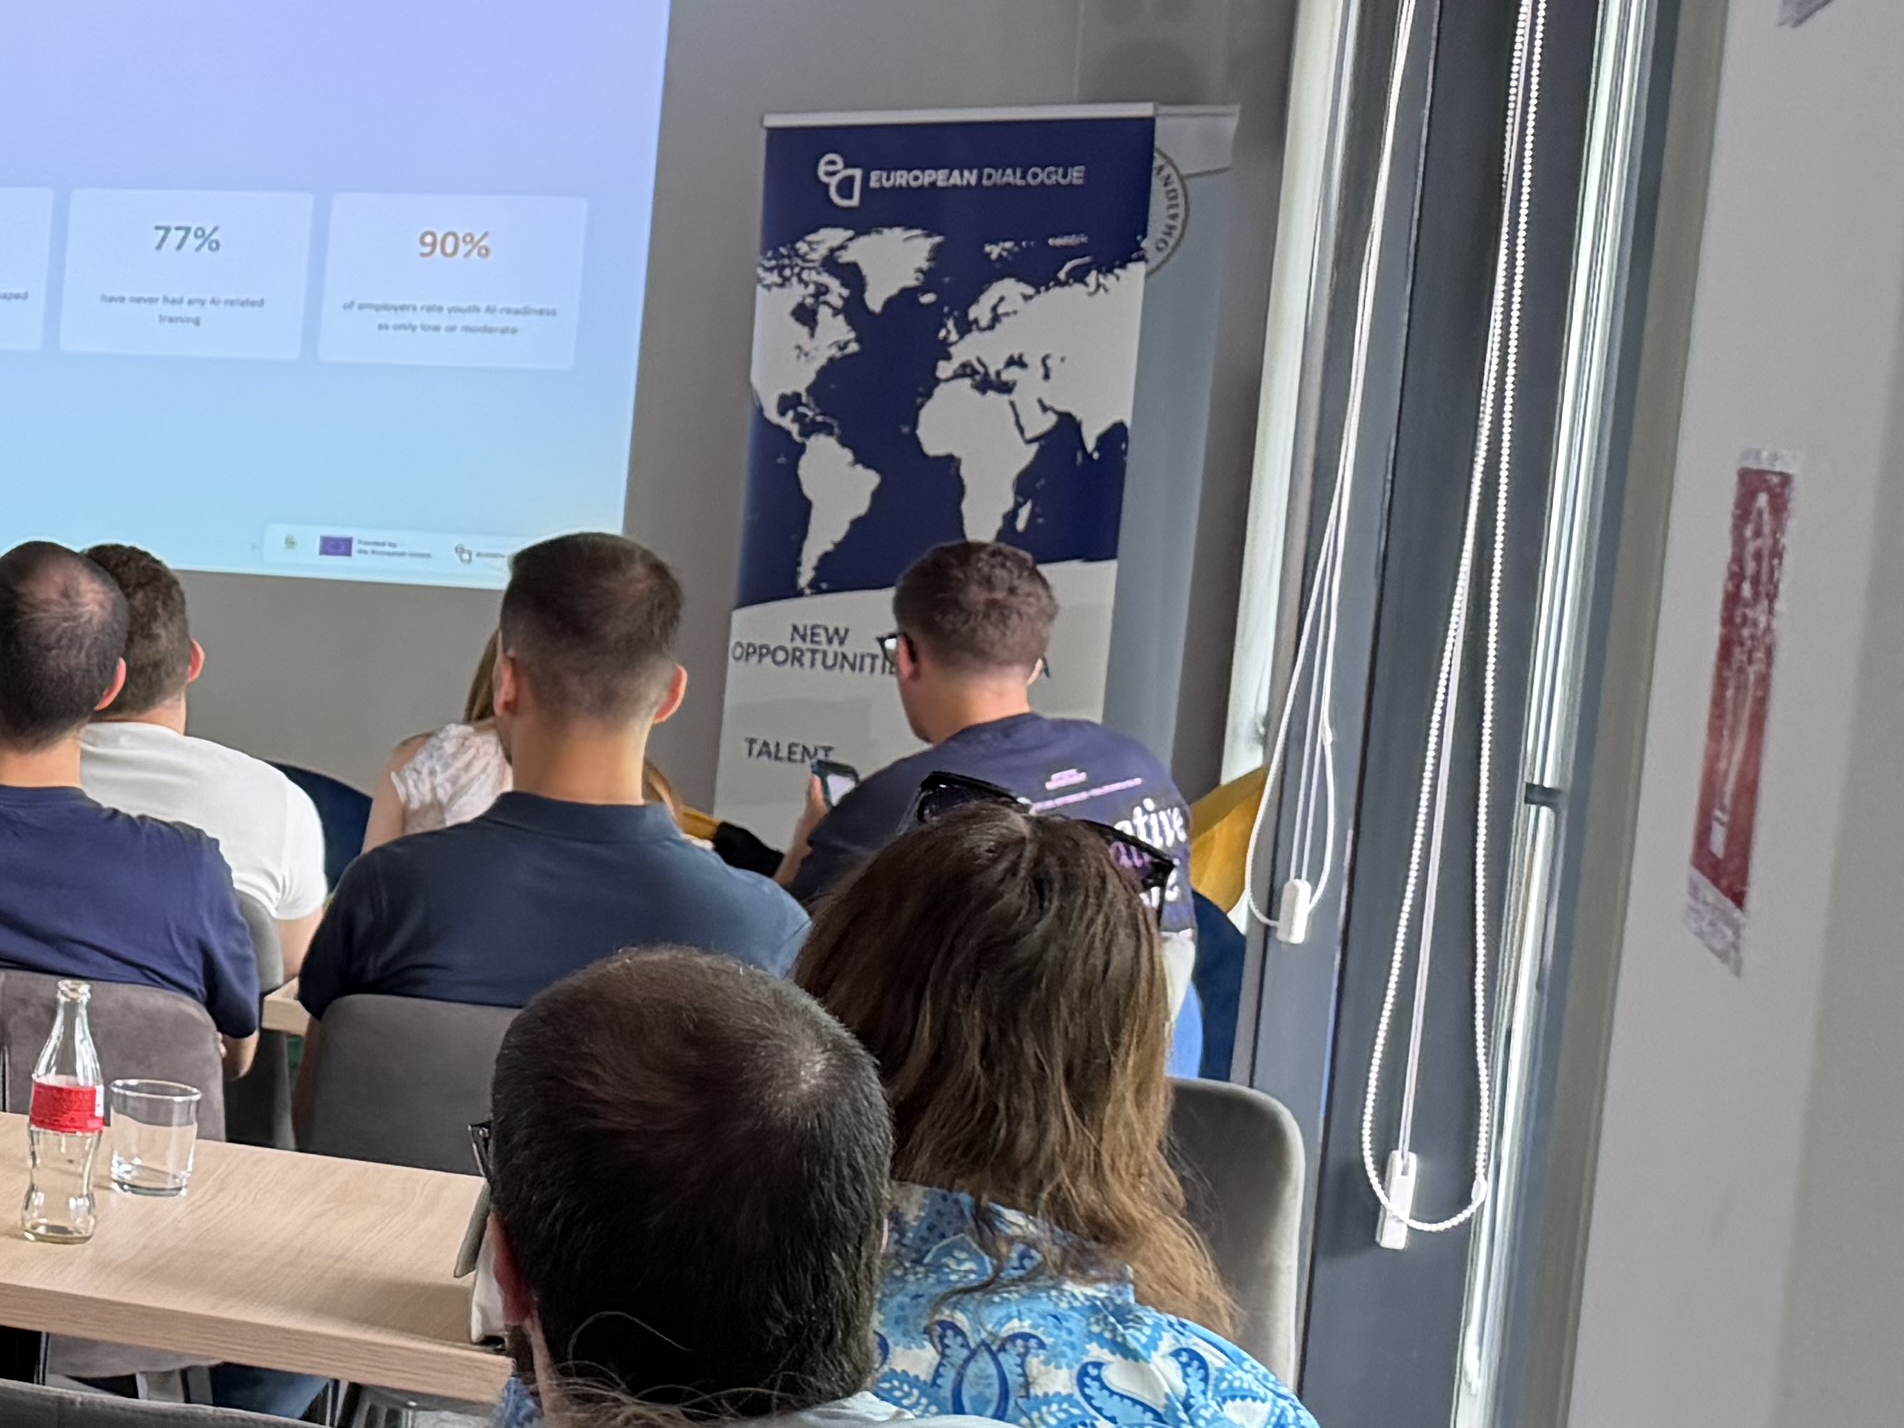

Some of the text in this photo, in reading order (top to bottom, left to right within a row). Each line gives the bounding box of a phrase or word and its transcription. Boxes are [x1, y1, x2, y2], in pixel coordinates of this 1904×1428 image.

[869, 166, 1086, 189] EUROPEAN DIALOGUE
[153, 224, 221, 253] 77%
[418, 230, 491, 260] 90%
[790, 623, 850, 647] NEW
[745, 737, 835, 765] TALENT
